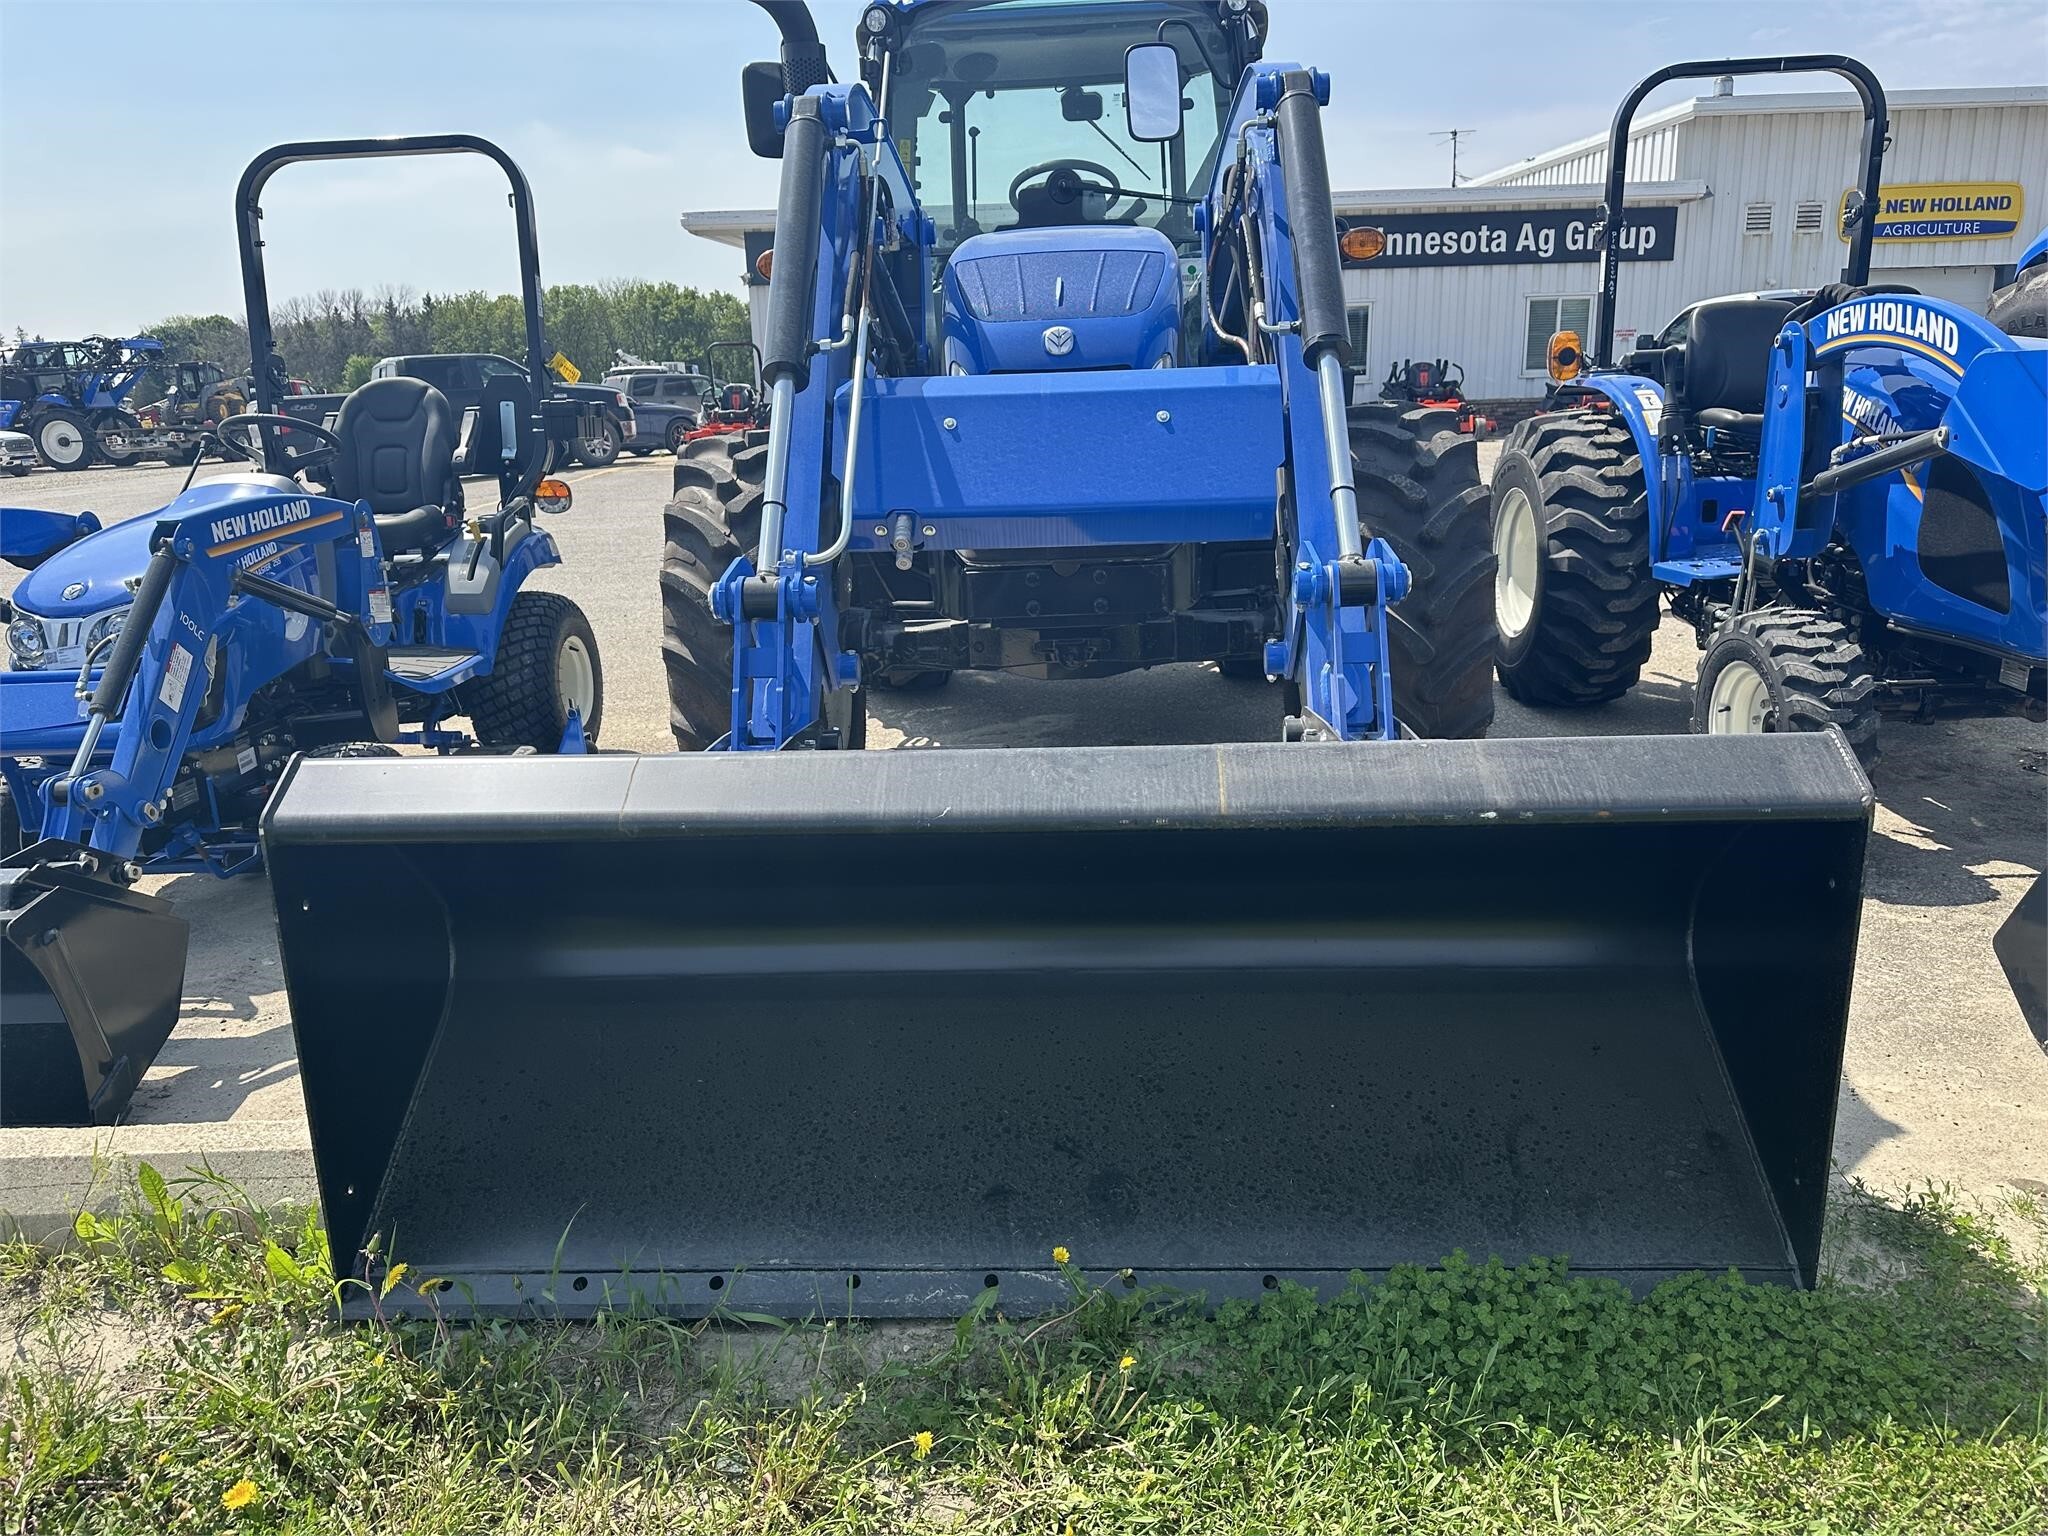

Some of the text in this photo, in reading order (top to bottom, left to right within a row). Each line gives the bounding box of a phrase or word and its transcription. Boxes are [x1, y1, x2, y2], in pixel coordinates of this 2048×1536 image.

[1885, 195, 2012, 214] NEW HOLLAND
[1377, 220, 1657, 258] nnesota Ag Grup
[1882, 222, 1981, 236] AGRICULTURE
[1826, 301, 1959, 357] NEW HOLLAND
[210, 499, 311, 543] NEW HOLLAND
[241, 541, 278, 569] HOLLAND
[179, 610, 205, 641] 100LC
